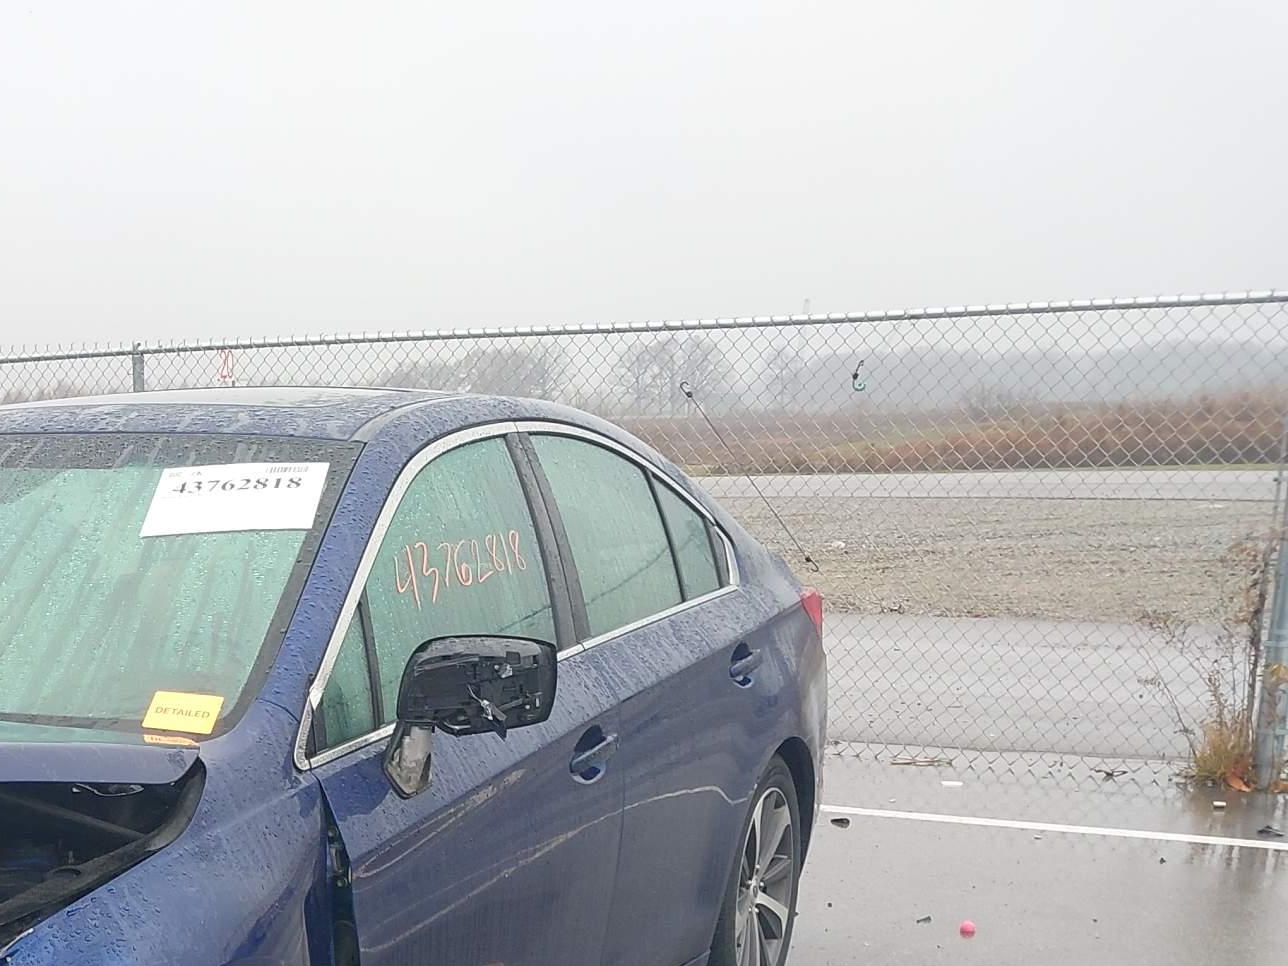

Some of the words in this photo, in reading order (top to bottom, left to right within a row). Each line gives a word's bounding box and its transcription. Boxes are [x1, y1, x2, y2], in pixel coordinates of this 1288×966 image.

[172, 476, 303, 494] 43762818
[393, 530, 527, 611] 43762818
[155, 706, 210, 719] DETAILED
